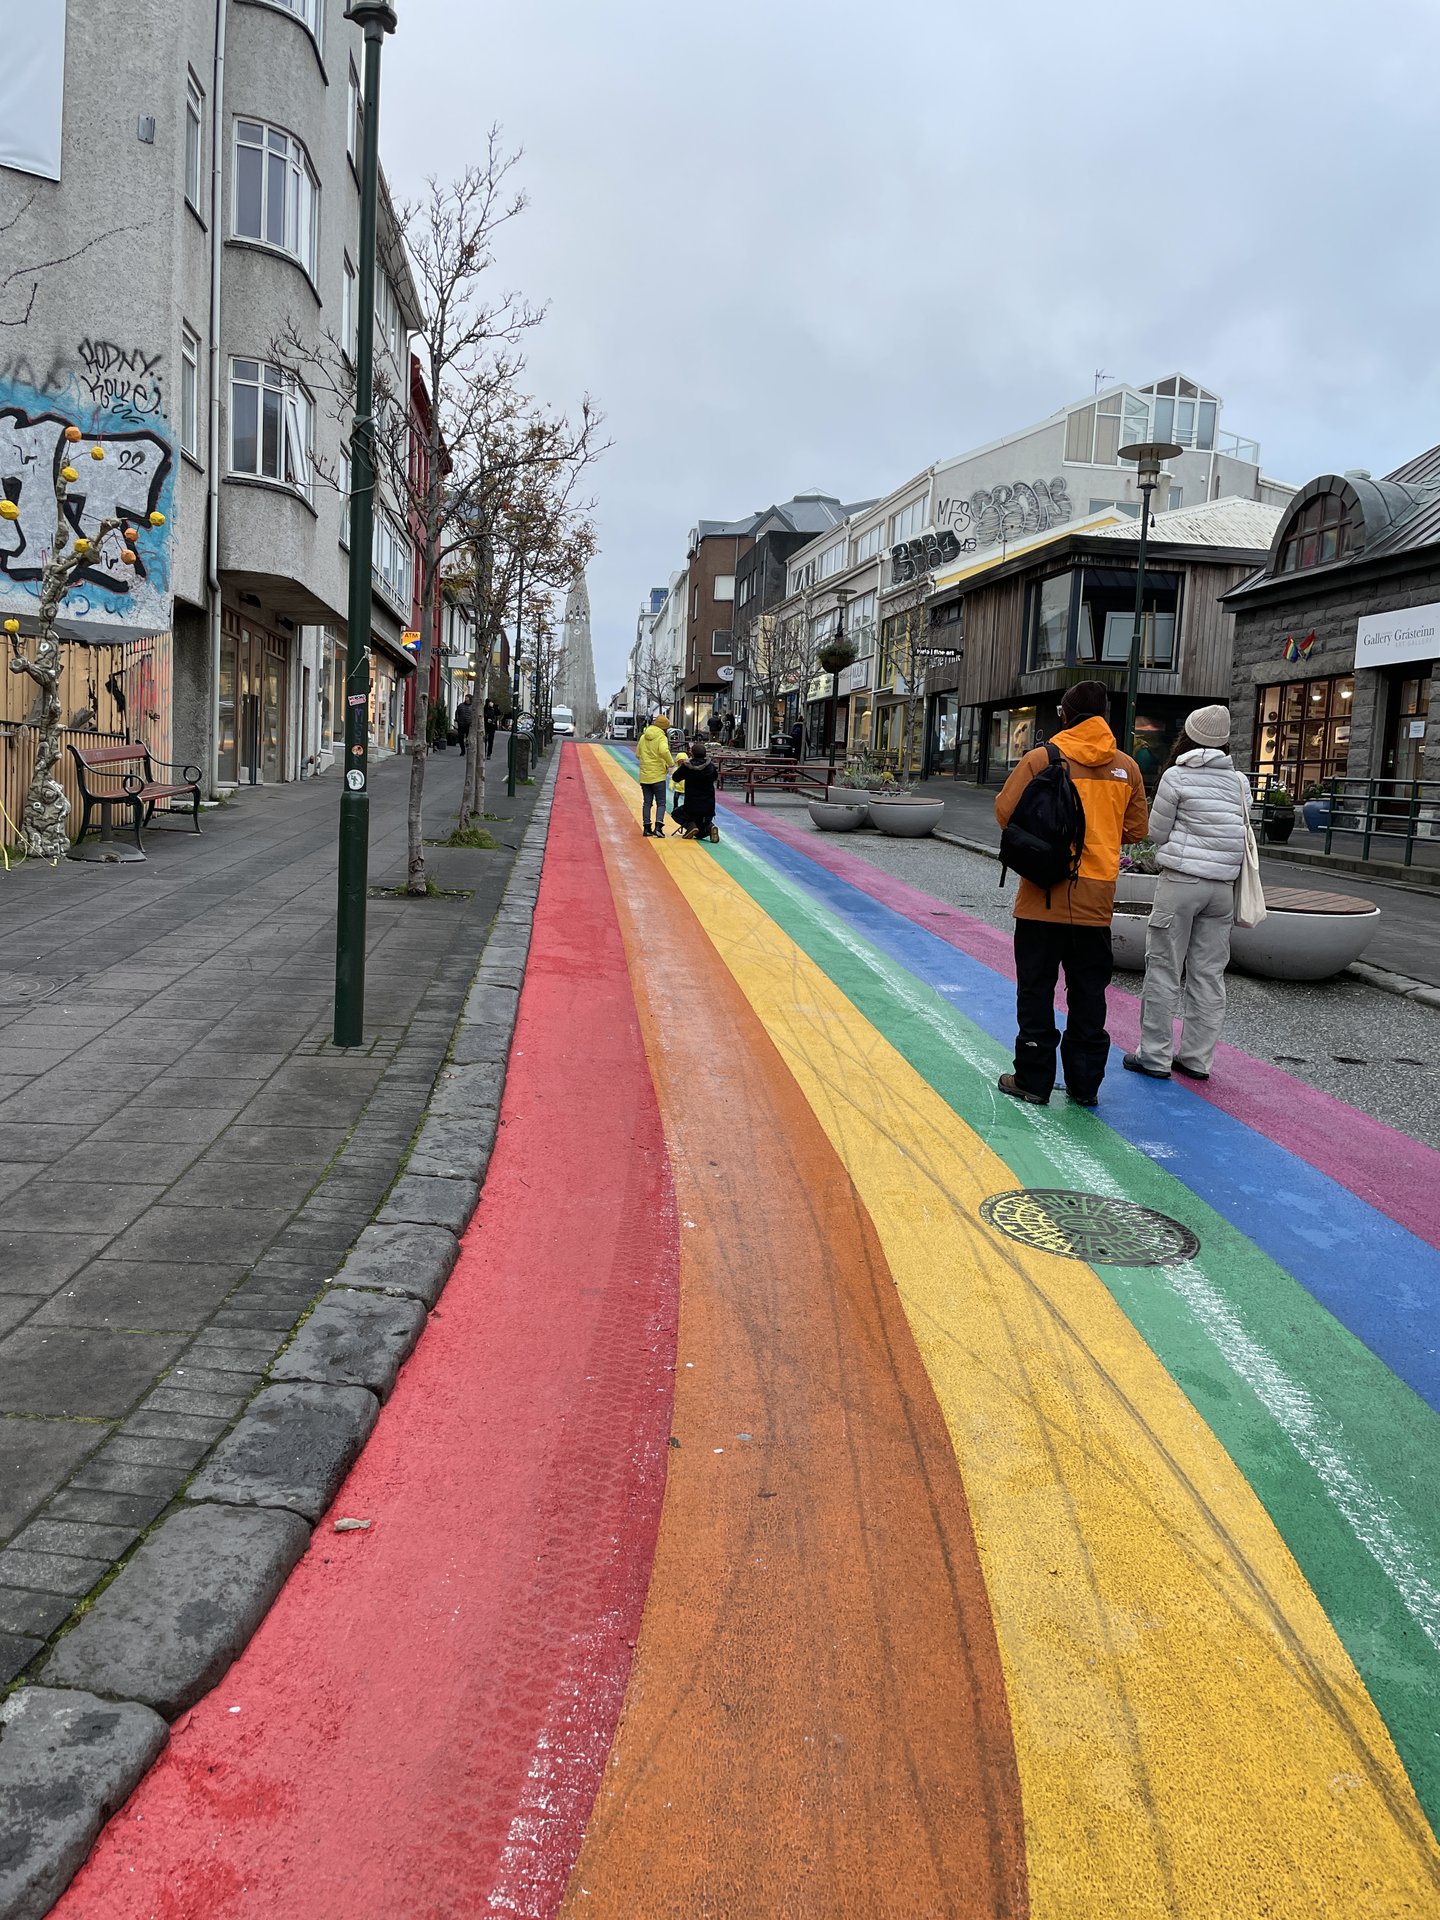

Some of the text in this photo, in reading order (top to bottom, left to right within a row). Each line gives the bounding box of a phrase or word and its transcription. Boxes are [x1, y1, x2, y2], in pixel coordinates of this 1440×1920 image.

[937, 497, 971, 532] MFS
[1363, 625, 1435, 646] Gallery Grásteinn
